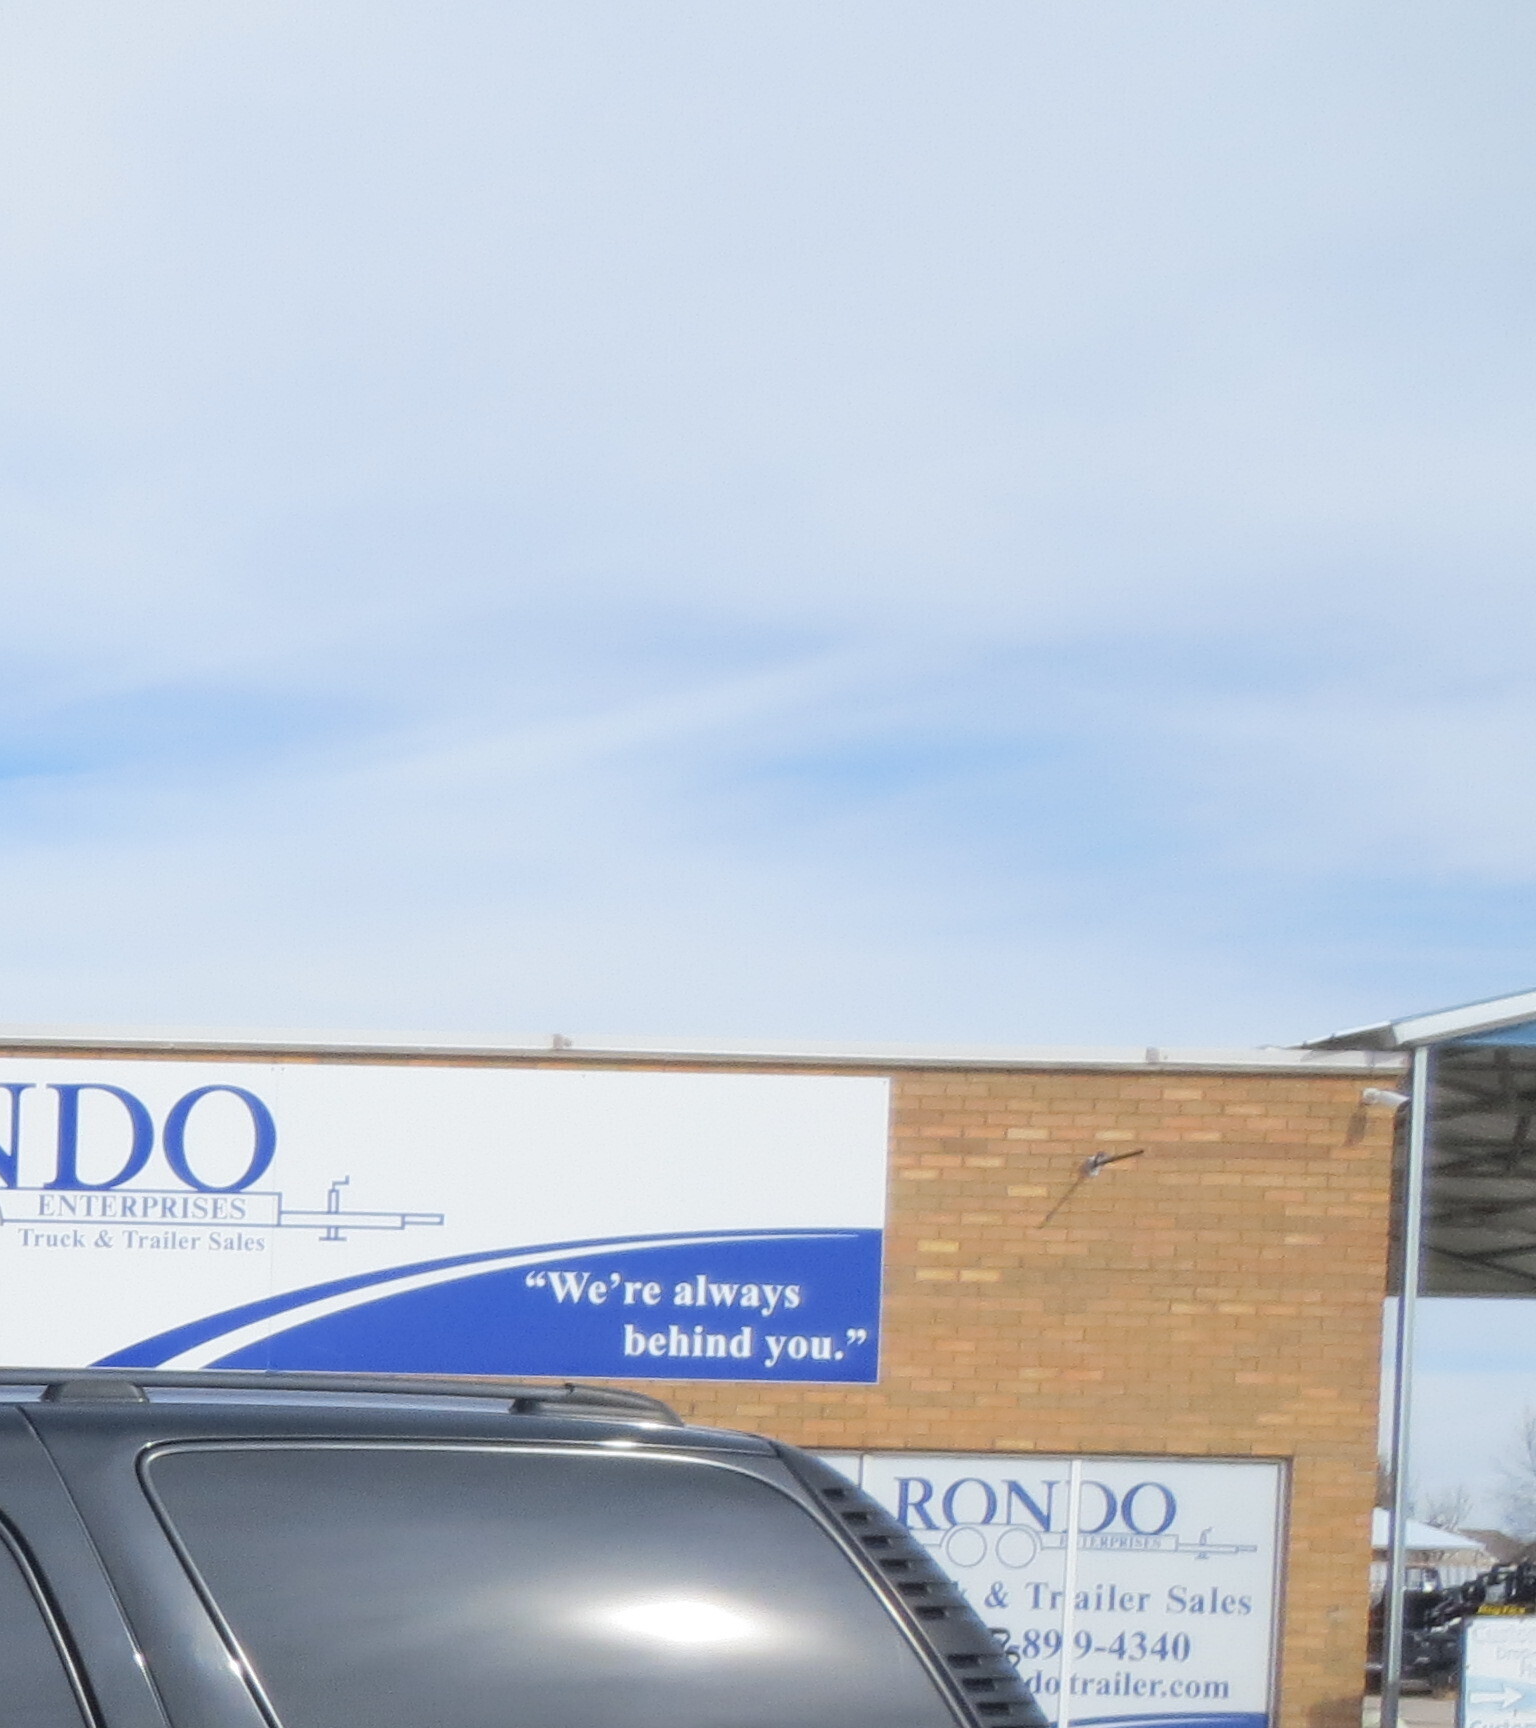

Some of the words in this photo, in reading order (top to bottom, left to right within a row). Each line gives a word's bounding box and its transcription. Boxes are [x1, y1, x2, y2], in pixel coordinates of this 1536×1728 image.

[37, 1193, 247, 1220] ENTERPRISES
[18, 1227, 86, 1248] Truck
[94, 1229, 114, 1249] &
[122, 1229, 201, 1251] Trailer
[208, 1231, 266, 1252] Sales
[673, 1274, 801, 1317] always
[623, 1324, 753, 1359] behind
[893, 1476, 1177, 1536] RONDO
[984, 1580, 1009, 1608] &
[1024, 1581, 1151, 1613] Trailer
[1165, 1583, 1252, 1616] Sales
